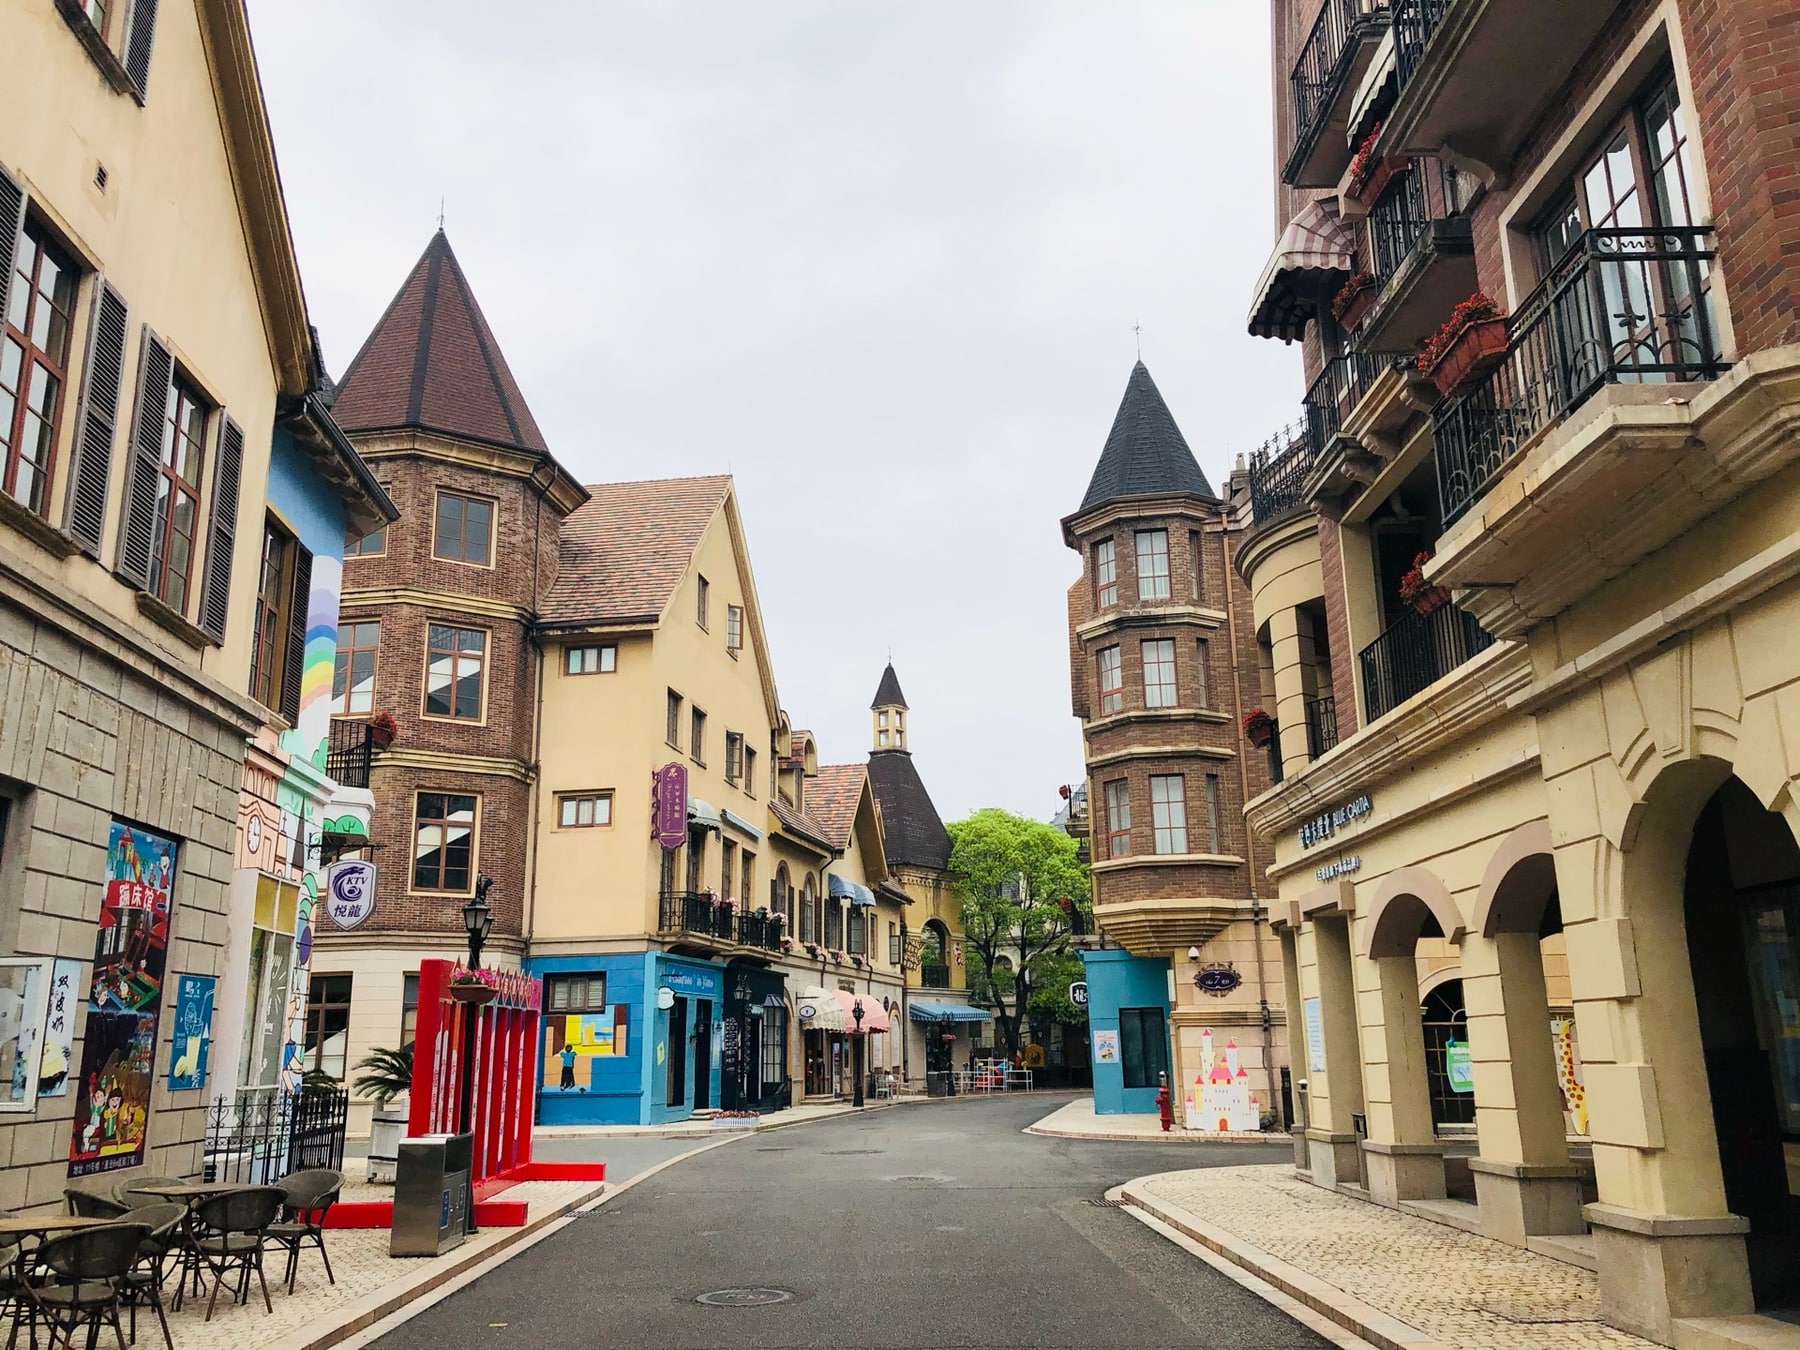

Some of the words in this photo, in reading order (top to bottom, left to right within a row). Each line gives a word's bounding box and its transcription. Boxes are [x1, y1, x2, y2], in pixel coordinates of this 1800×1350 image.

[346, 876, 369, 885] KTV
[119, 882, 154, 912] 蹦床馆
[1214, 975, 1221, 985] 7
[52, 975, 70, 1033] 双皮奶
